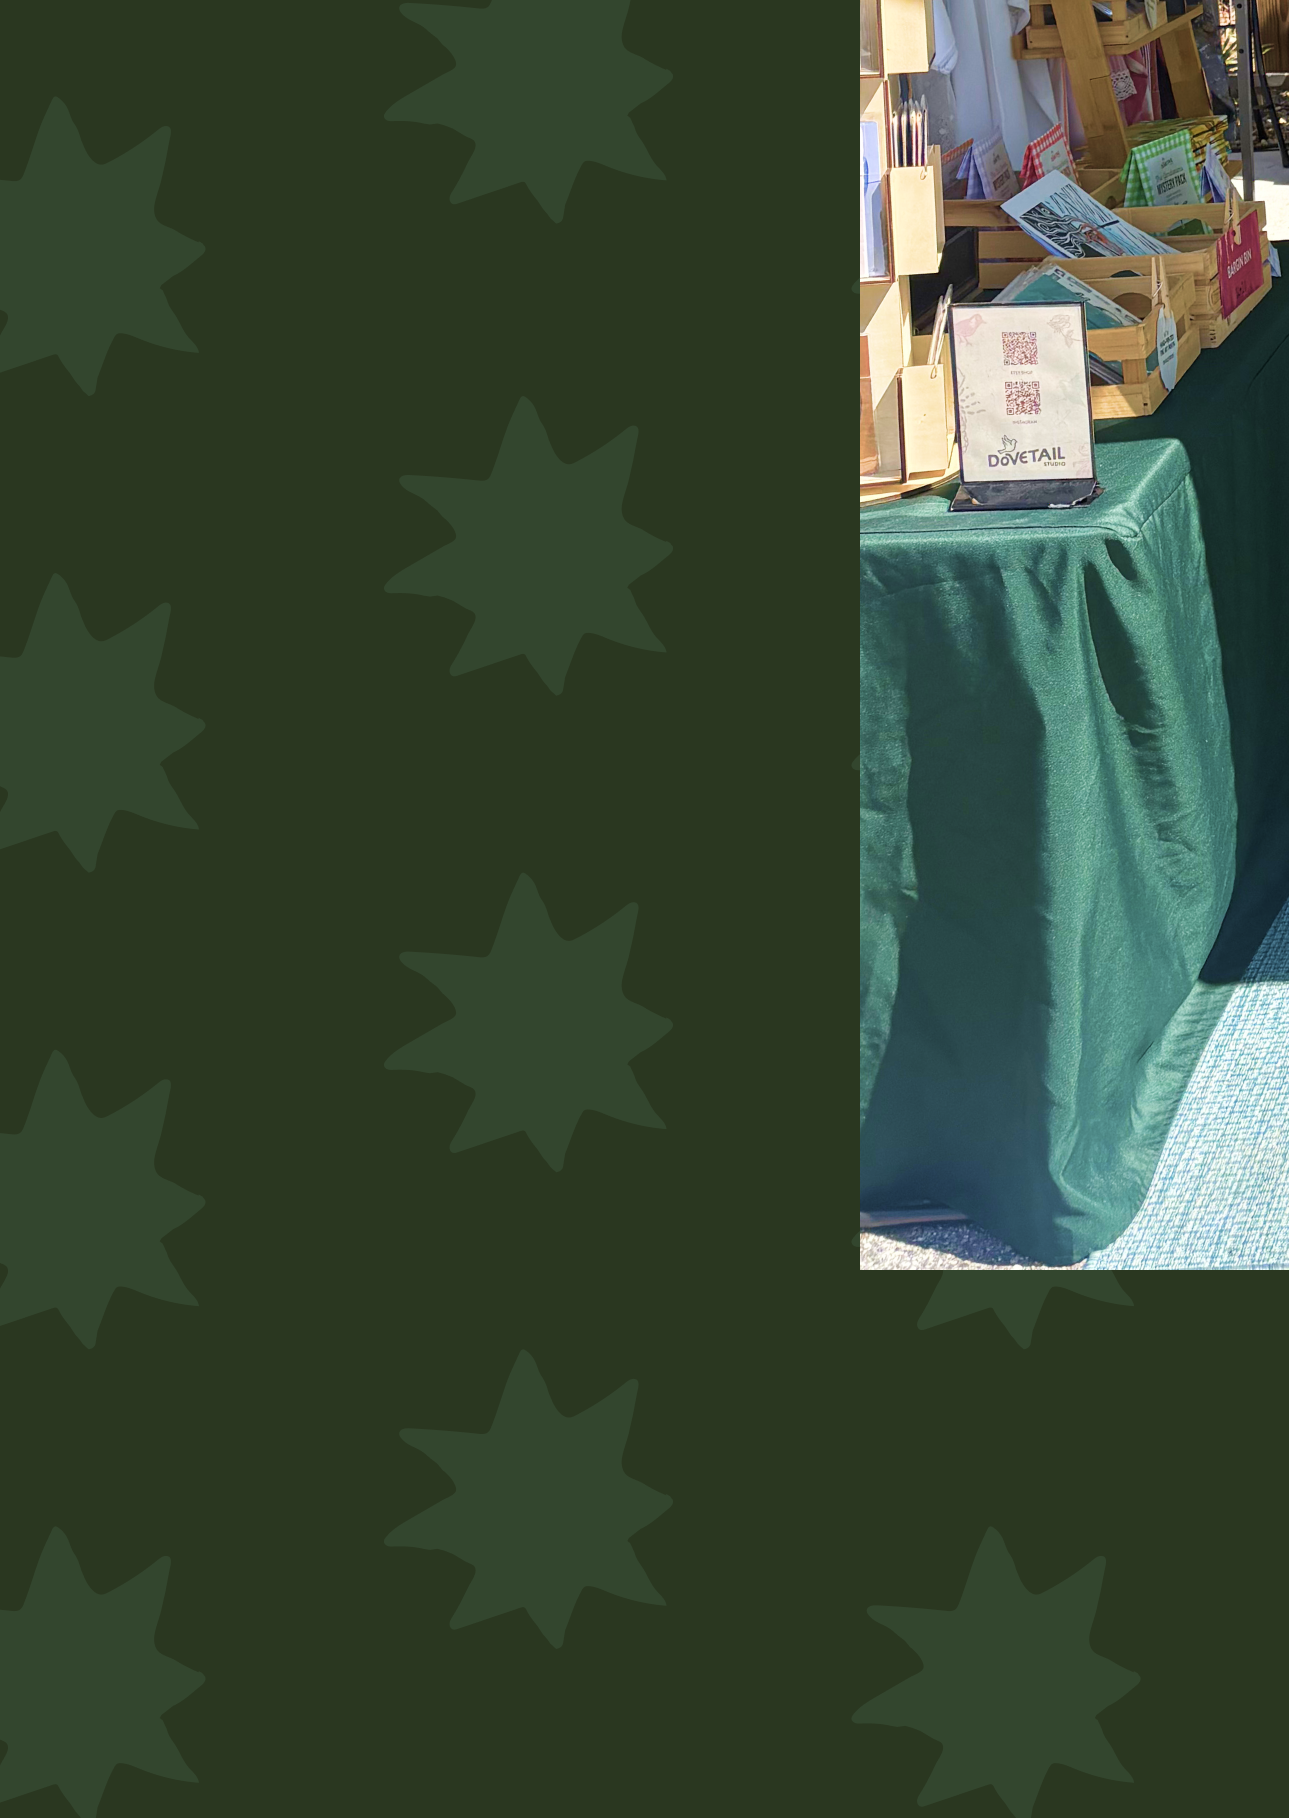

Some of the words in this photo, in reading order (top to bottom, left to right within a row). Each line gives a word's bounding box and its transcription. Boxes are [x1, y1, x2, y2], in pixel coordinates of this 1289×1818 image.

[1174, 173, 1188, 187] PACK
[1227, 257, 1243, 279] BARGIN
[1243, 248, 1252, 266] BIN
[988, 446, 1066, 467] DOVETAIL
